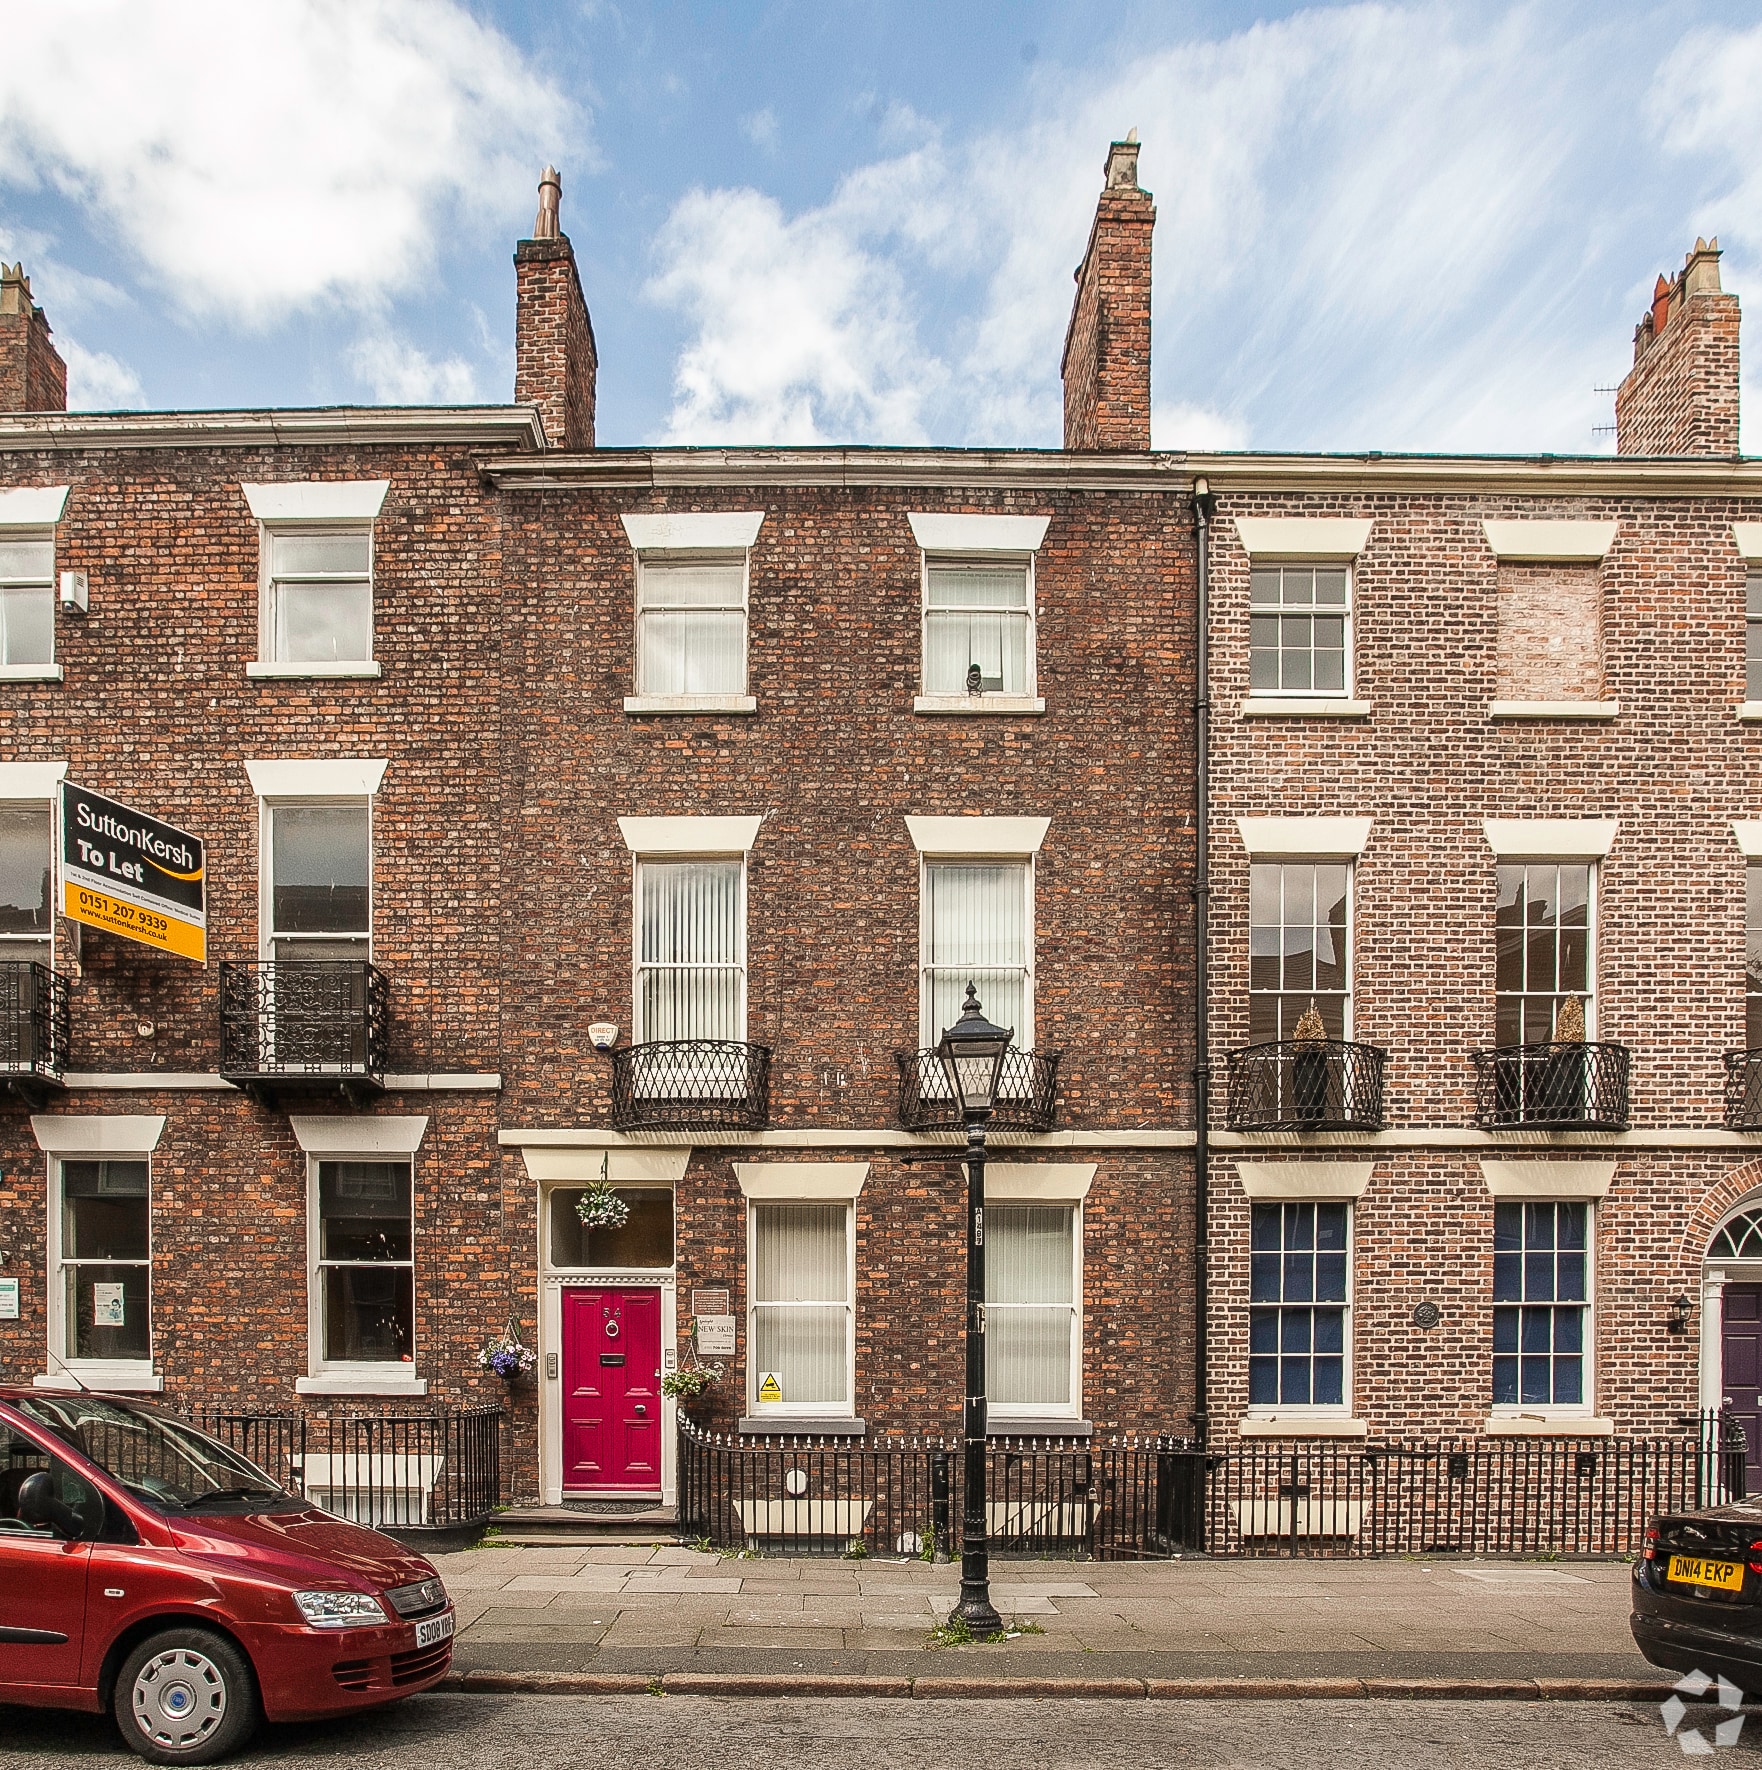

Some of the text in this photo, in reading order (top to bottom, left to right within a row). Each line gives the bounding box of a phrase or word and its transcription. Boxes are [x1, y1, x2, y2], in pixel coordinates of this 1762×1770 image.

[77, 803, 193, 870] SuttonKersh
[77, 838, 144, 883] To Let
[79, 906, 168, 942] www.suttonkersh.co.uk
[80, 891, 168, 931] 0151 207 9339
[1674, 1559, 1734, 1582] DN14 EKP
[420, 1620, 440, 1643] SD08
